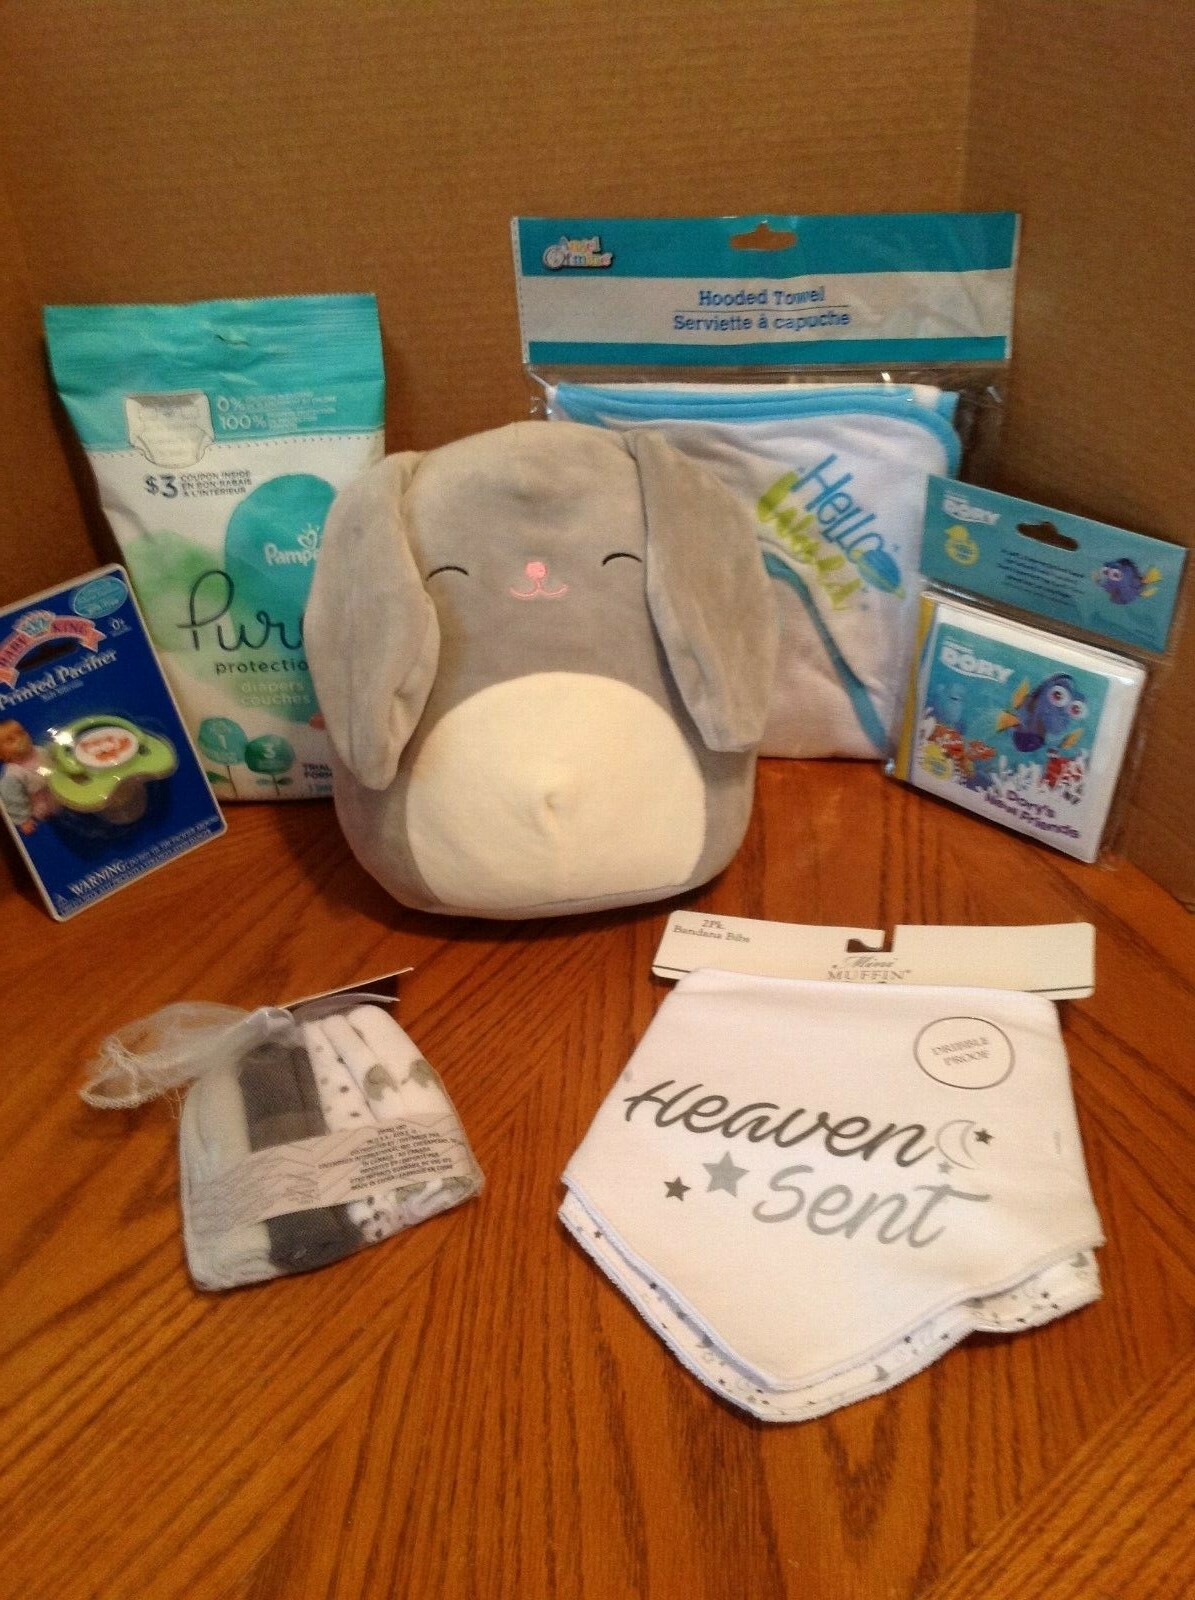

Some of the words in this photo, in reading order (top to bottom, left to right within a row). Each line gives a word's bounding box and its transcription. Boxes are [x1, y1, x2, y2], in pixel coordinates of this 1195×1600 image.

[698, 289, 768, 306] Hooded
[772, 286, 826, 305] Towel
[673, 315, 752, 331] Serviette
[773, 311, 852, 331] capuche
[145, 474, 178, 498] $3
[264, 542, 317, 567] Pamp
[215, 659, 310, 675] protectio
[673, 924, 723, 941] Bandana
[726, 931, 751, 944] Bibs
[623, 1080, 936, 1168] Heaven
[752, 1164, 993, 1250] Sent
